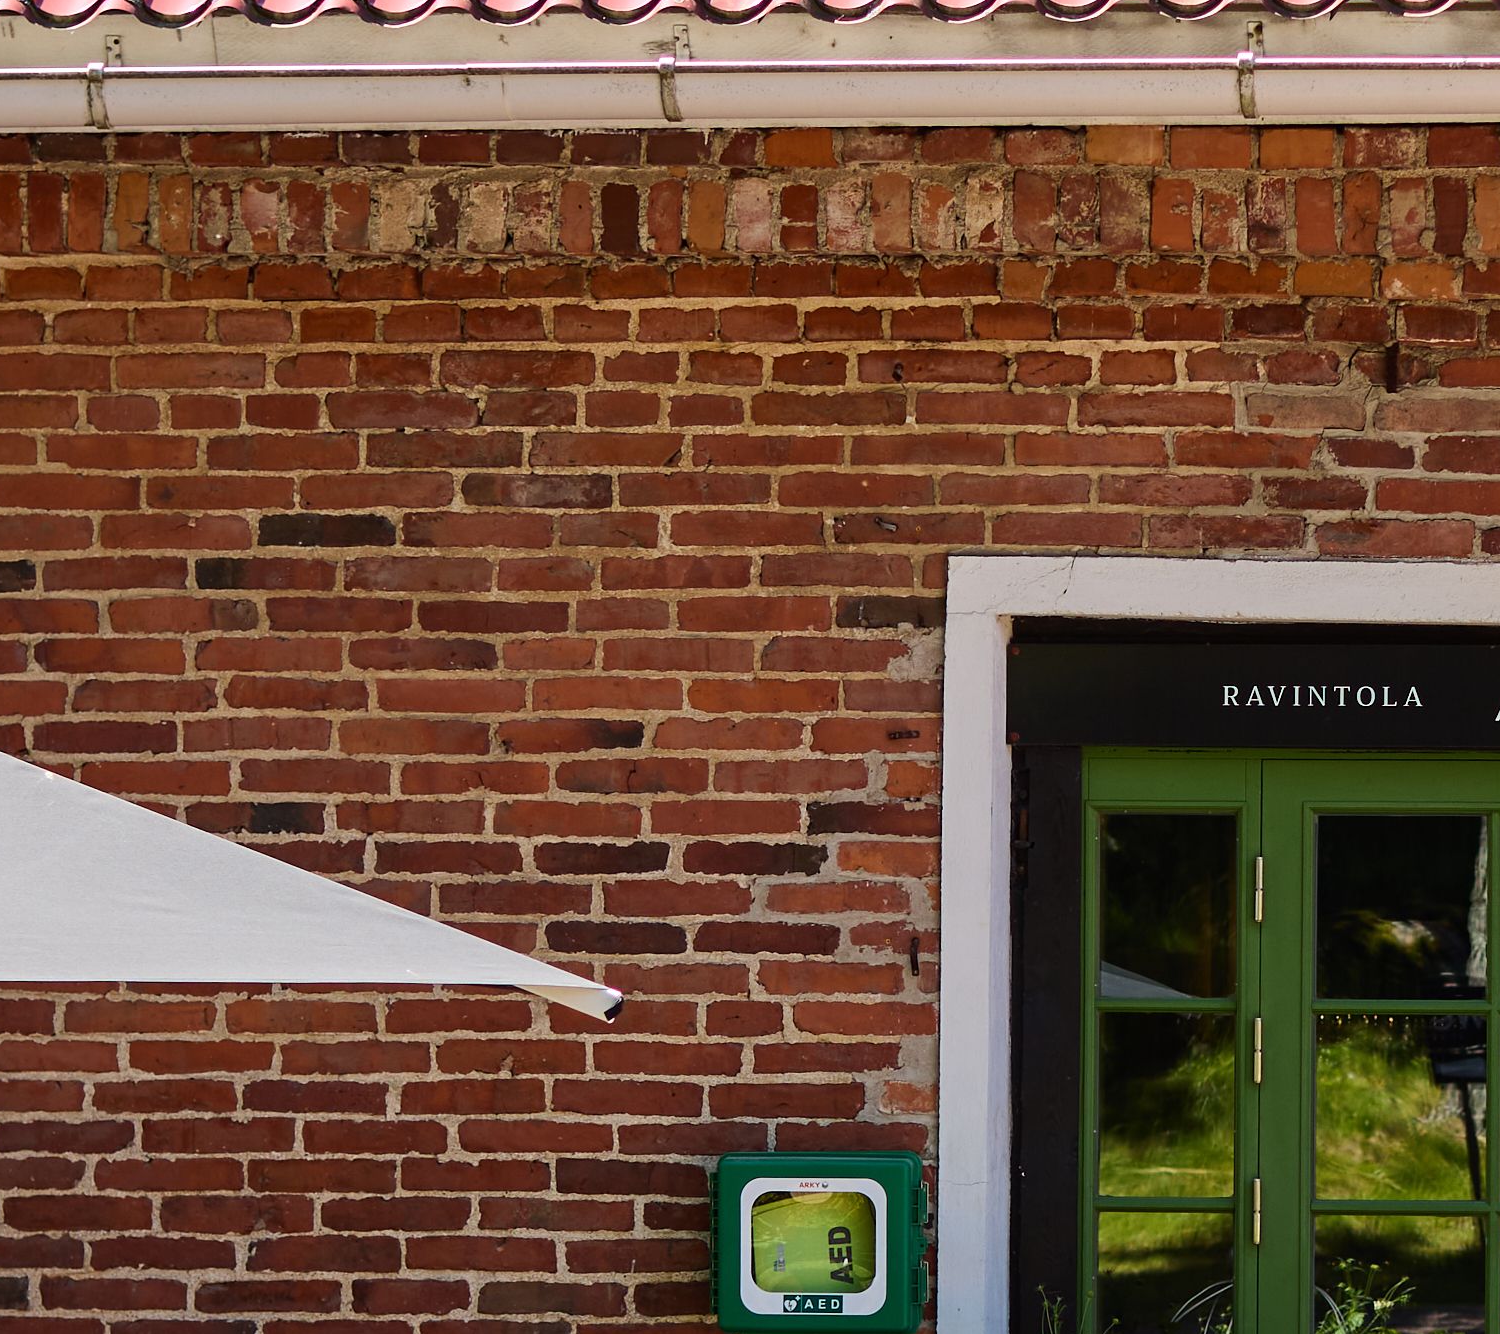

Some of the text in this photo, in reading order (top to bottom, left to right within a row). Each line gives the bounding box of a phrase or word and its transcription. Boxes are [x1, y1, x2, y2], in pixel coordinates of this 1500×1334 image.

[1221, 684, 1423, 707] RAVINTOLA
[828, 1226, 854, 1284] AED
[804, 1299, 840, 1310] AED
